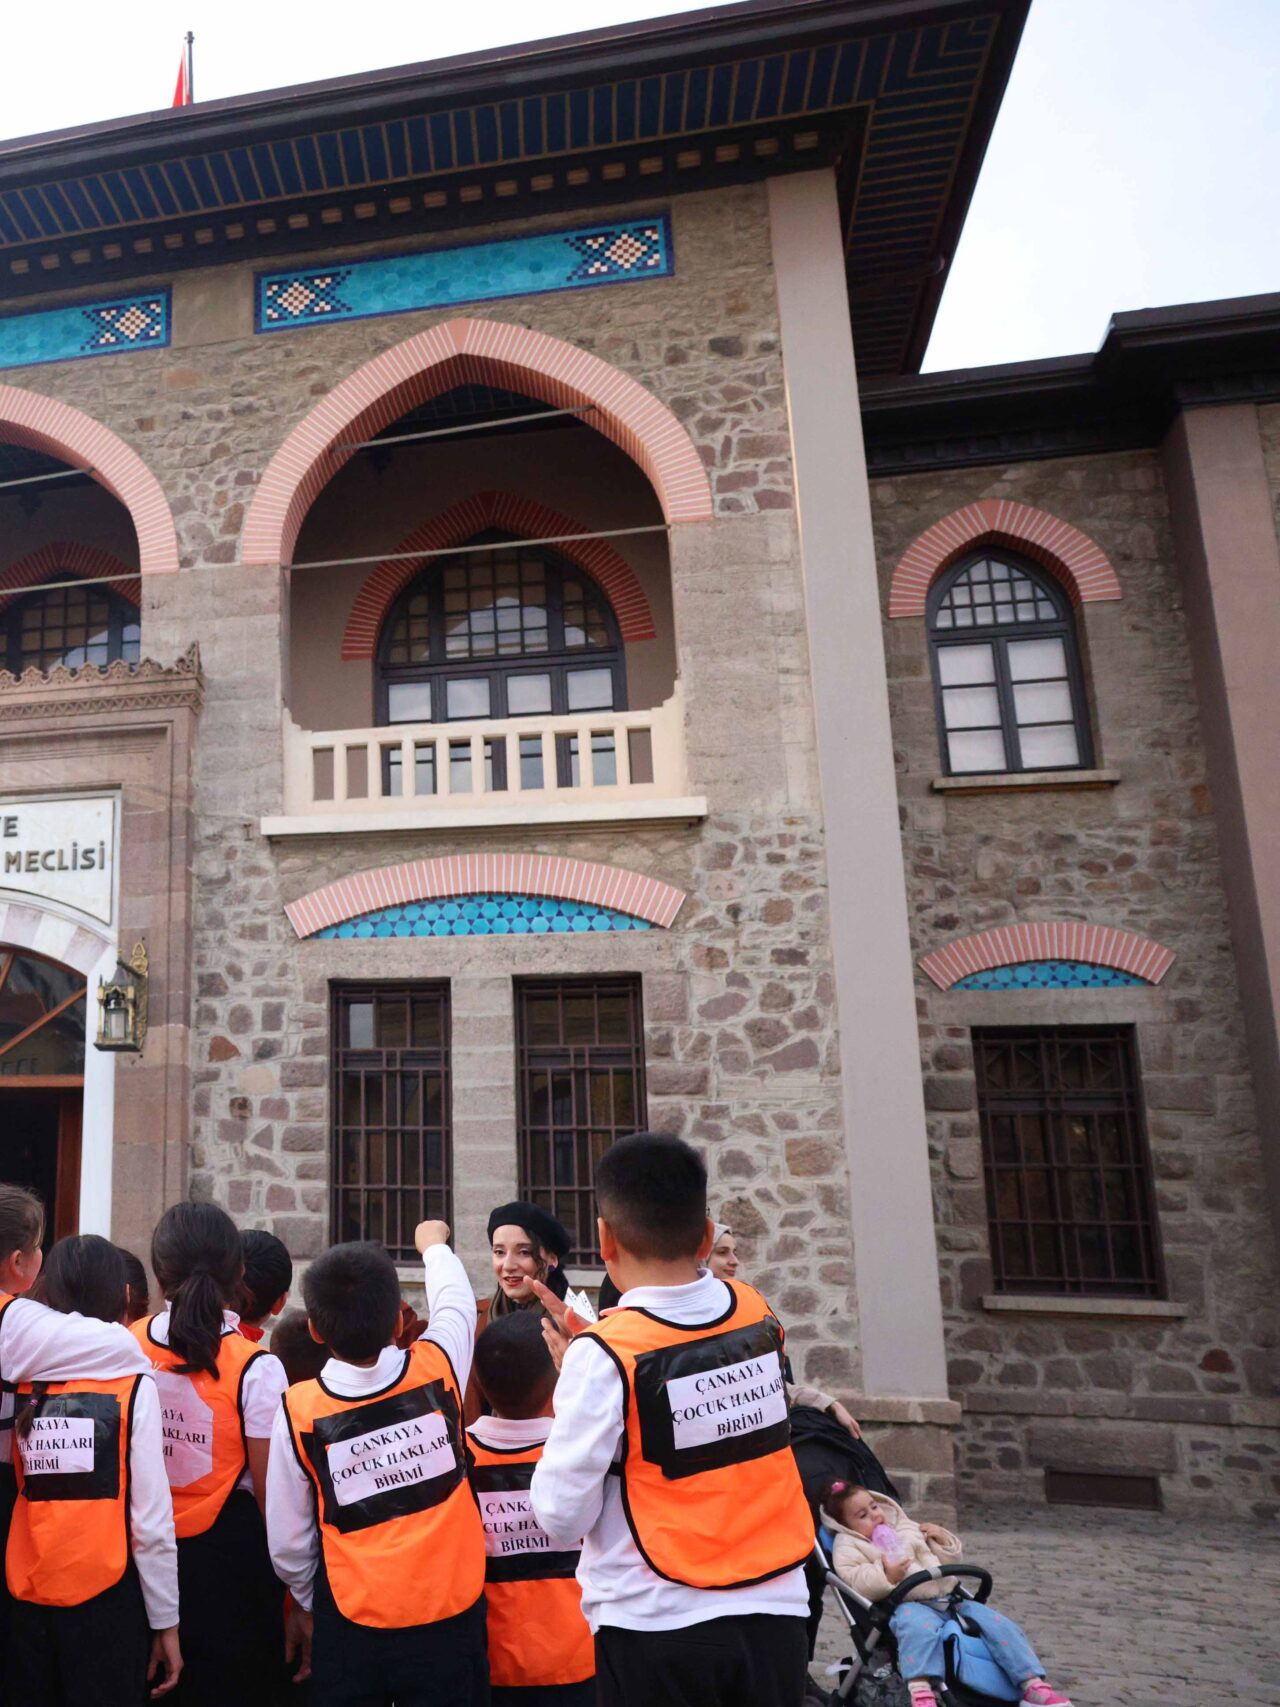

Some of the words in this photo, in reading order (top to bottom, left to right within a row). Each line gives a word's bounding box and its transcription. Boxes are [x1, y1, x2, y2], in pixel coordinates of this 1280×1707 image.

[5, 841, 105, 873] MECLİSİ
[695, 1362, 764, 1395] ÇANKAYA
[672, 1396, 728, 1425] ÇOCUK
[730, 1376, 784, 1408] HAKLARI
[716, 1408, 764, 1436] BİRİMİ
[36, 1437, 93, 1451] HAKLARI
[350, 1423, 423, 1456] ÇANKAYA
[331, 1457, 384, 1485] ÇOCUK
[386, 1433, 449, 1465] HAKLARI
[374, 1463, 424, 1489] BİRİMİ
[483, 1521, 514, 1534] CUK
[501, 1534, 550, 1552] BİRİMİ
